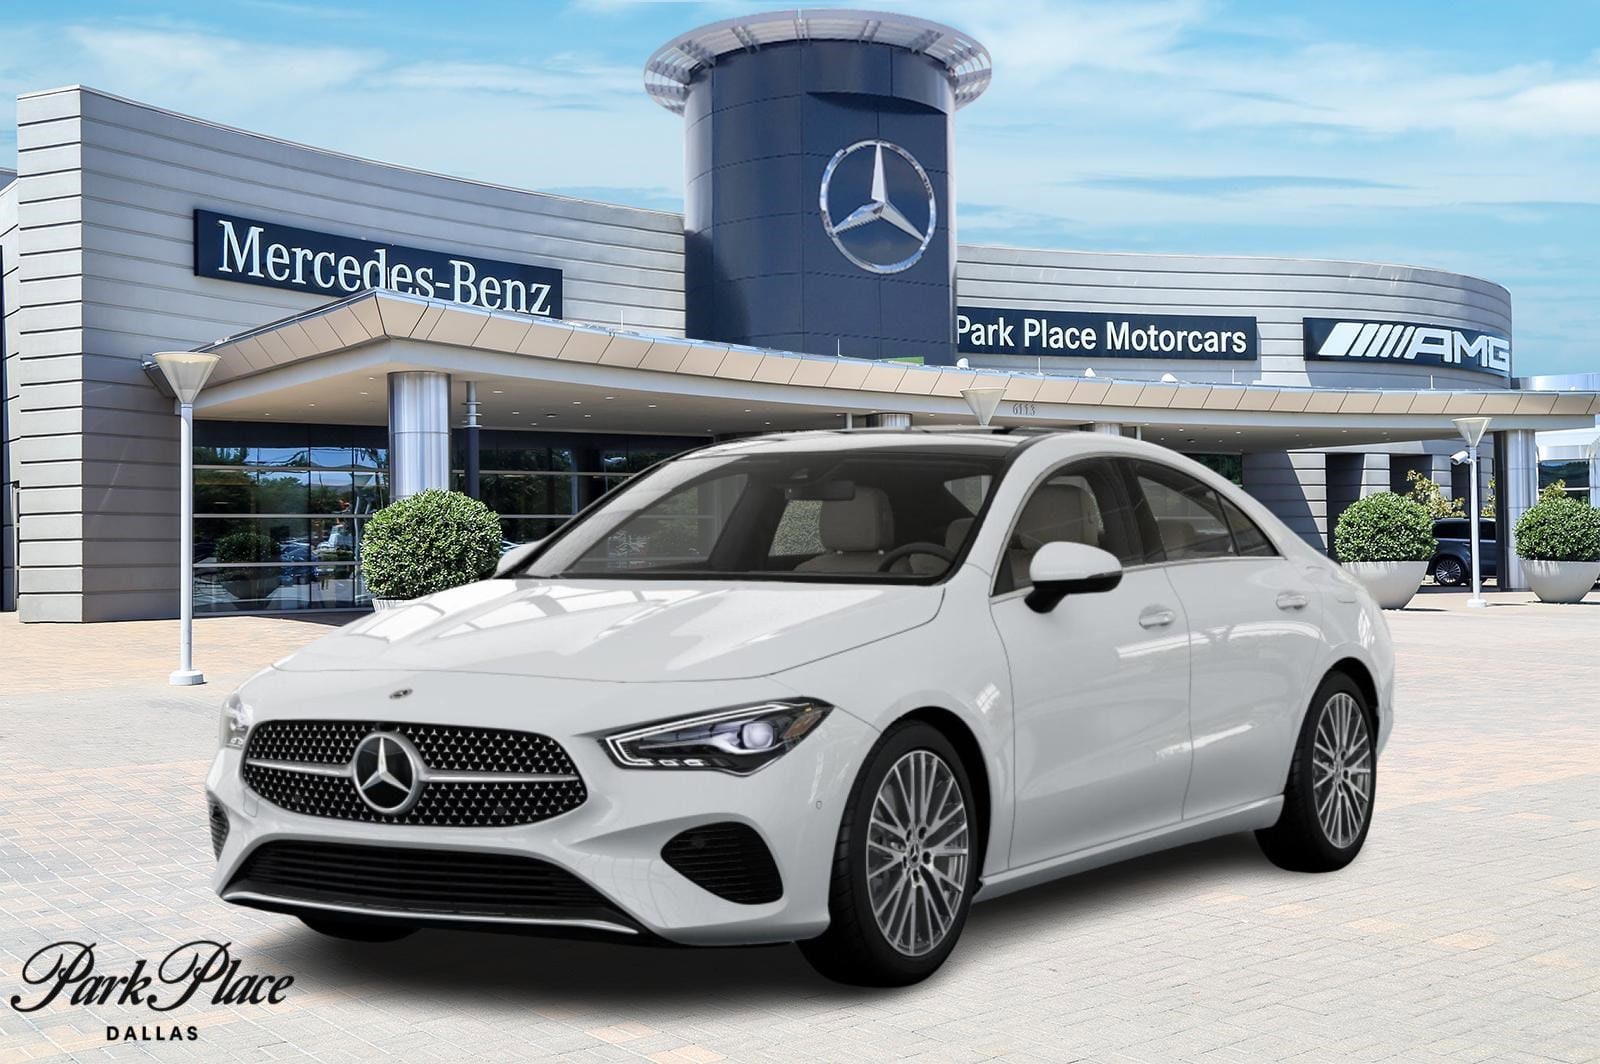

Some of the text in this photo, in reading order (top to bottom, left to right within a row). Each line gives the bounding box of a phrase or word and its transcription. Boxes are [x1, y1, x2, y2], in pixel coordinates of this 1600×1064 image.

[218, 219, 552, 316] Mercedes-Benz
[957, 314, 1247, 353] Park Place Motorcars
[1403, 327, 1510, 371] AMG
[1012, 403, 1036, 416] 6113
